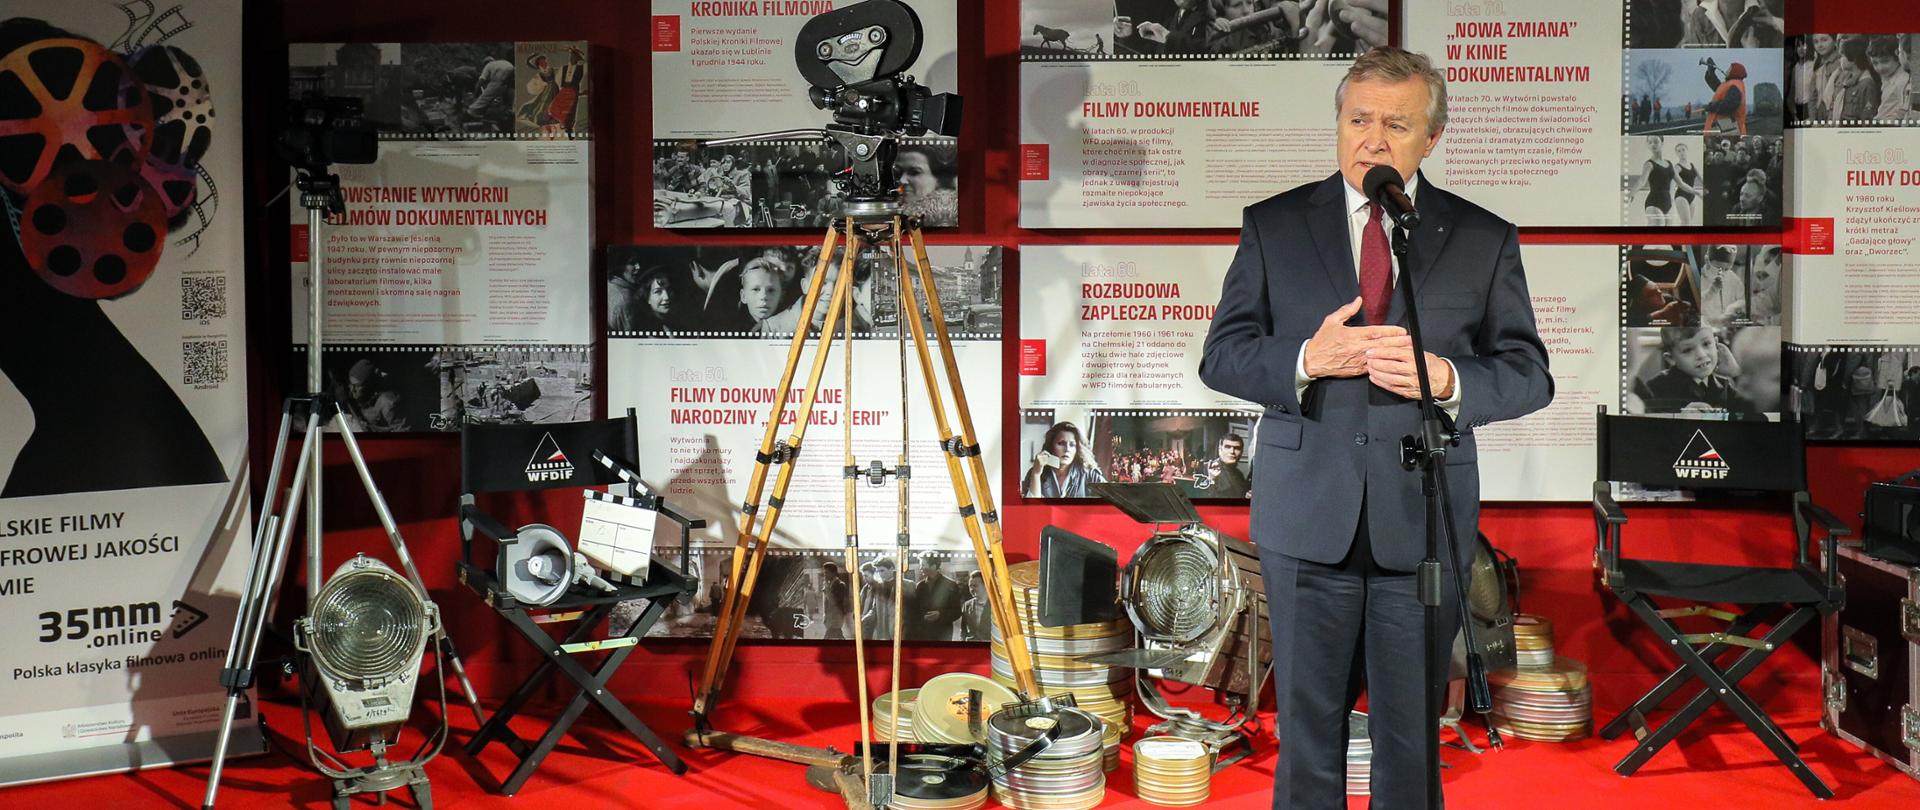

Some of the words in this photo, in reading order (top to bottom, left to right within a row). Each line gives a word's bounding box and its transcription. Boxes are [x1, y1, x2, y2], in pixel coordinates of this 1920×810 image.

[691, 0, 758, 16] KRONIKA
[763, 0, 833, 16] FILMOWA
[1447, 22, 1503, 40] „NOWA
[1507, 22, 1577, 38] ZMIANA”
[1447, 44, 1461, 60] W
[1467, 44, 1507, 60] KINIE
[1447, 66, 1590, 82] DOKUMENTALNYM
[1083, 101, 1129, 118] FILMY
[1134, 101, 1260, 118] DOKUMENTALNE
[1847, 170, 1895, 186] FILMY
[1901, 170, 1920, 186] DO
[340, 186, 416, 202] OWSTANIE
[422, 183, 508, 203] WYTWÓRNI
[396, 210, 546, 226] DOKUMENTALNYCH
[1082, 283, 1180, 299] ROZBUDOWA
[1082, 305, 1157, 320] ZAPLECZA
[671, 387, 716, 403] FILMY
[721, 388, 842, 404] DOKUMNTLNE
[671, 409, 757, 425] NARODZINY
[762, 410, 837, 427] „ZANEJ
[0, 517, 53, 537] LSKIE
[60, 512, 125, 532] FILMY
[0, 544, 88, 566] FROWEJ
[94, 533, 179, 559] JAKOŚCI
[38, 600, 161, 642] 35mm
[13, 660, 62, 680] Polska
[66, 658, 121, 674] klasyka
[126, 654, 185, 668] filmowa
[190, 648, 231, 662] onlin
